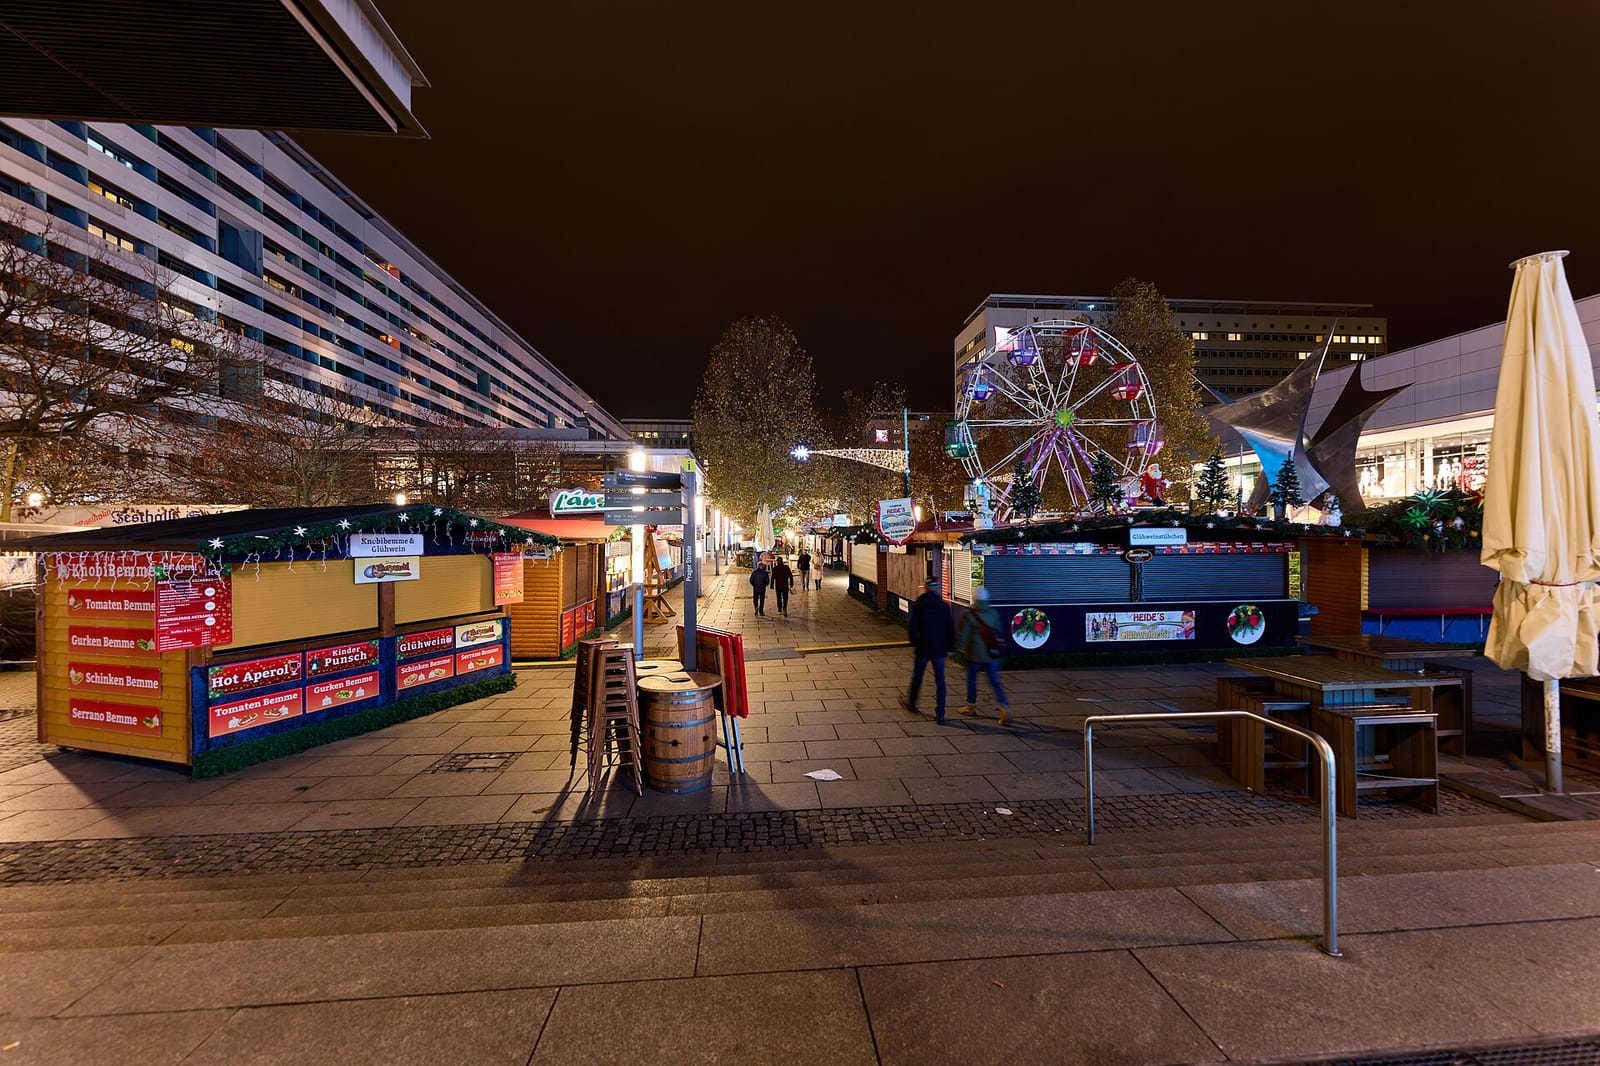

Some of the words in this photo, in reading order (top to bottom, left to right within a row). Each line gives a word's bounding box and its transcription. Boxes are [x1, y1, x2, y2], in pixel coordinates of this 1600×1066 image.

[371, 545, 406, 553] Glühwein
[685, 545, 693, 564] Straße
[685, 564, 694, 582] Prager
[85, 598, 123, 611] Tomaten
[124, 599, 155, 612] Bemme
[71, 635, 102, 647] Gurken
[104, 637, 135, 649] Bemme
[400, 637, 447, 652] Glühwein
[324, 652, 368, 667] Punsch
[332, 647, 361, 657] Kinder
[461, 651, 481, 661] Serrano
[401, 662, 429, 674] Schinken
[430, 657, 451, 668] Bemme
[85, 672, 125, 686] Schinken
[126, 676, 159, 689] Bemme
[211, 675, 239, 688] Hot
[243, 666, 289, 683] Aperol
[313, 682, 344, 694] Gurken
[345, 675, 374, 687] Bemme
[215, 700, 262, 717] Tomaten
[263, 692, 298, 706] Bemme
[72, 708, 105, 721] Serrano
[106, 711, 138, 725] Bemme
